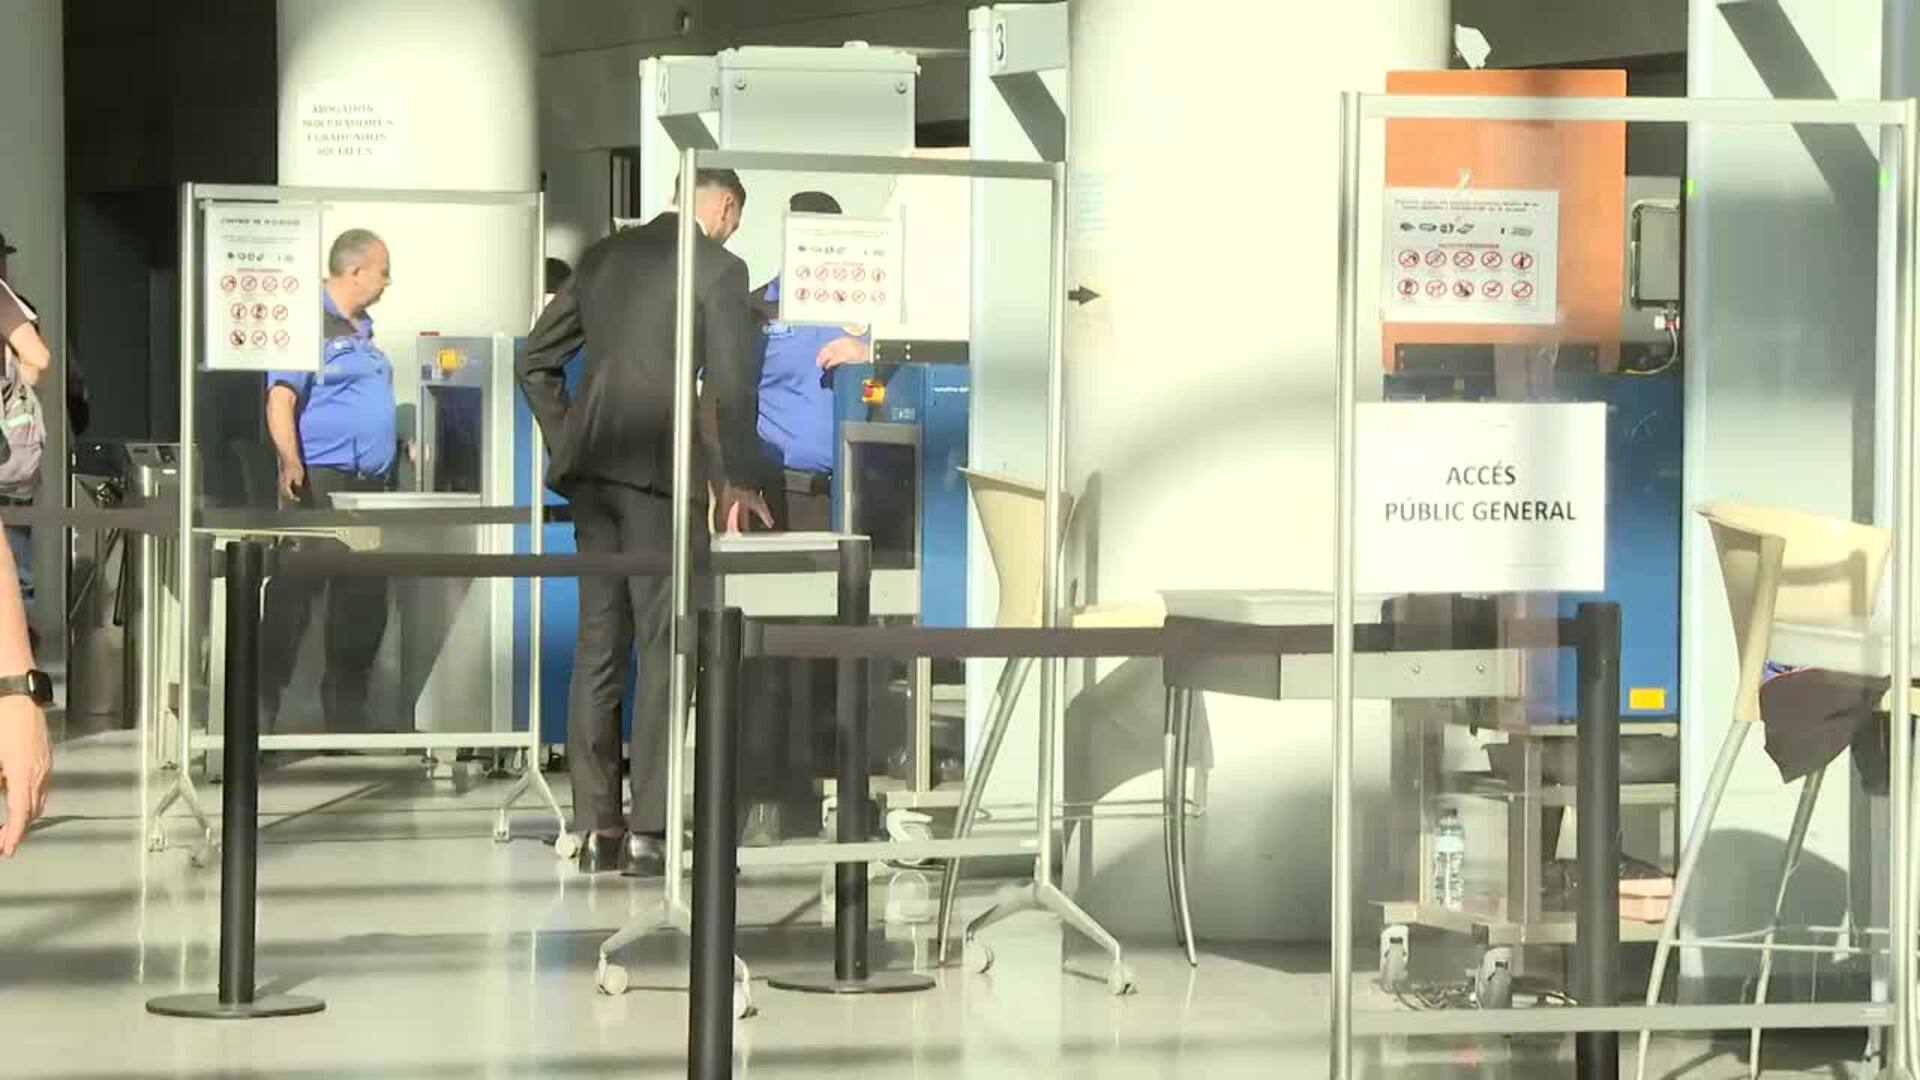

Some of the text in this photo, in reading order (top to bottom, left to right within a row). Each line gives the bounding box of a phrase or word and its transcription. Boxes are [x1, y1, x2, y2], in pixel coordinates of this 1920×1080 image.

[995, 22, 1005, 62] 3
[1446, 460, 1516, 486] ACCÉS
[1385, 497, 1577, 522] PÚBLIC GENERAL
